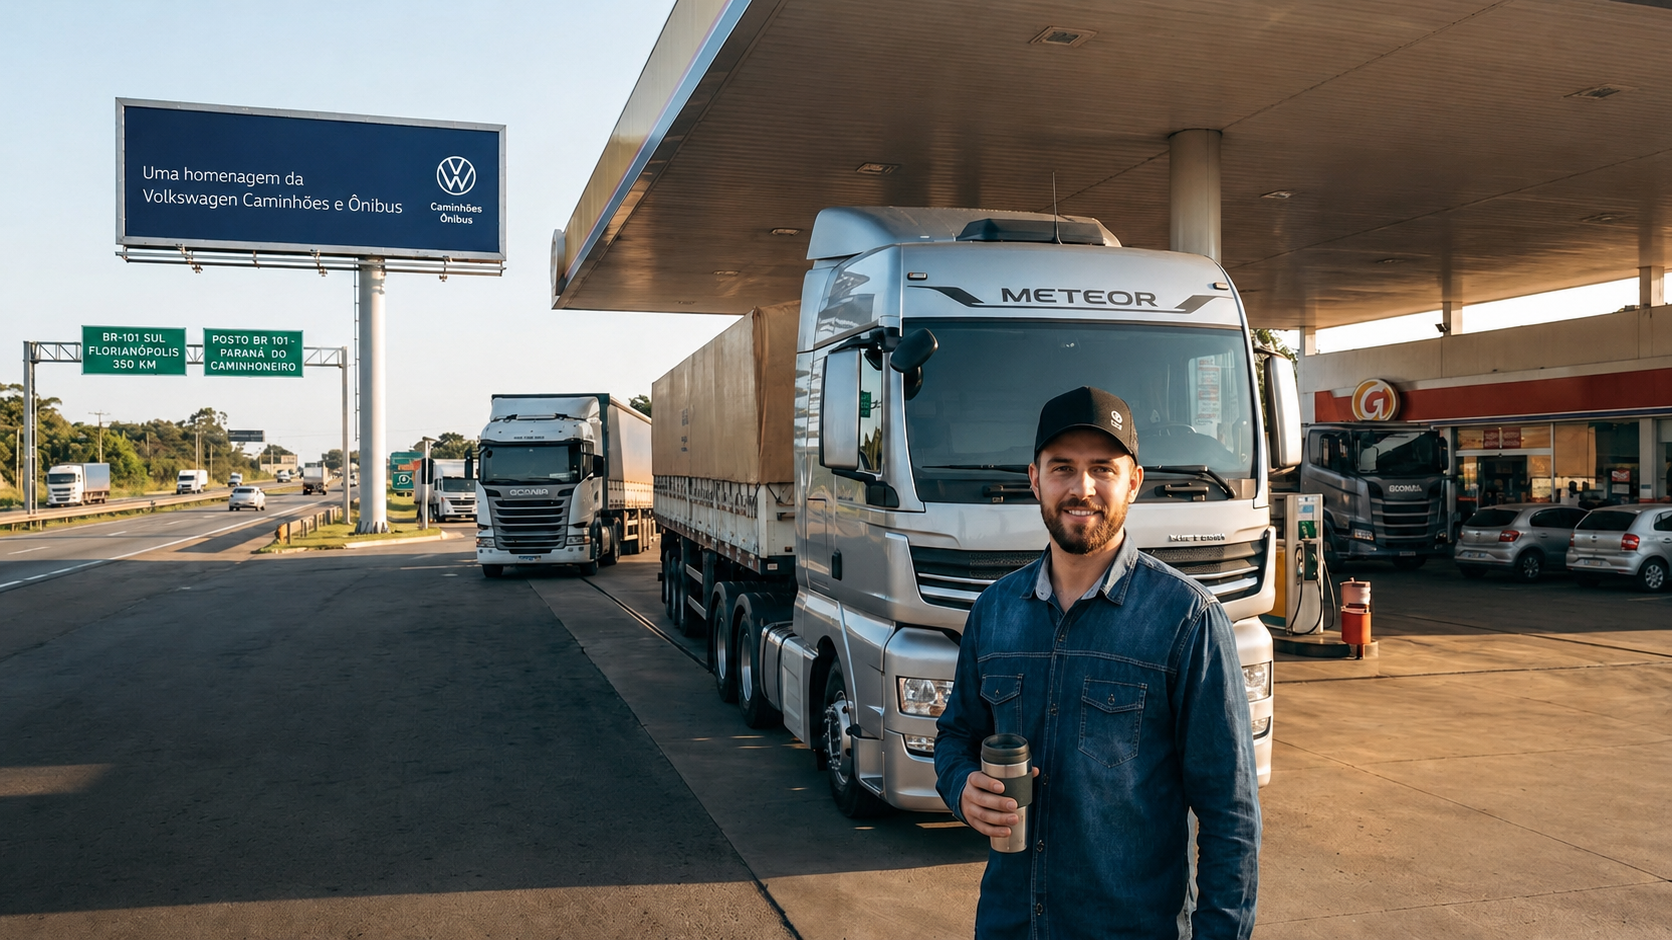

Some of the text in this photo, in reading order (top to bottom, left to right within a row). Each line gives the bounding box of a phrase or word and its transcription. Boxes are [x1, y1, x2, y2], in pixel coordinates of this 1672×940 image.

[143, 165, 304, 187] Uma homenagem da
[143, 189, 402, 213] Volkswagen Caminhões e Ônibus
[430, 202, 482, 213] Caminhões
[440, 213, 473, 224] Ônibus
[1001, 288, 1158, 307] METEOR
[102, 332, 166, 343] BR-101 SUL
[212, 335, 249, 345] POSTO
[253, 335, 268, 345] BR
[272, 336, 288, 345] 101
[88, 344, 179, 357] FLORIANÓPOLIS
[221, 347, 287, 358] PARANÁ DO
[113, 359, 156, 370] 350 KM
[210, 361, 296, 371] CAMINHONEIRO
